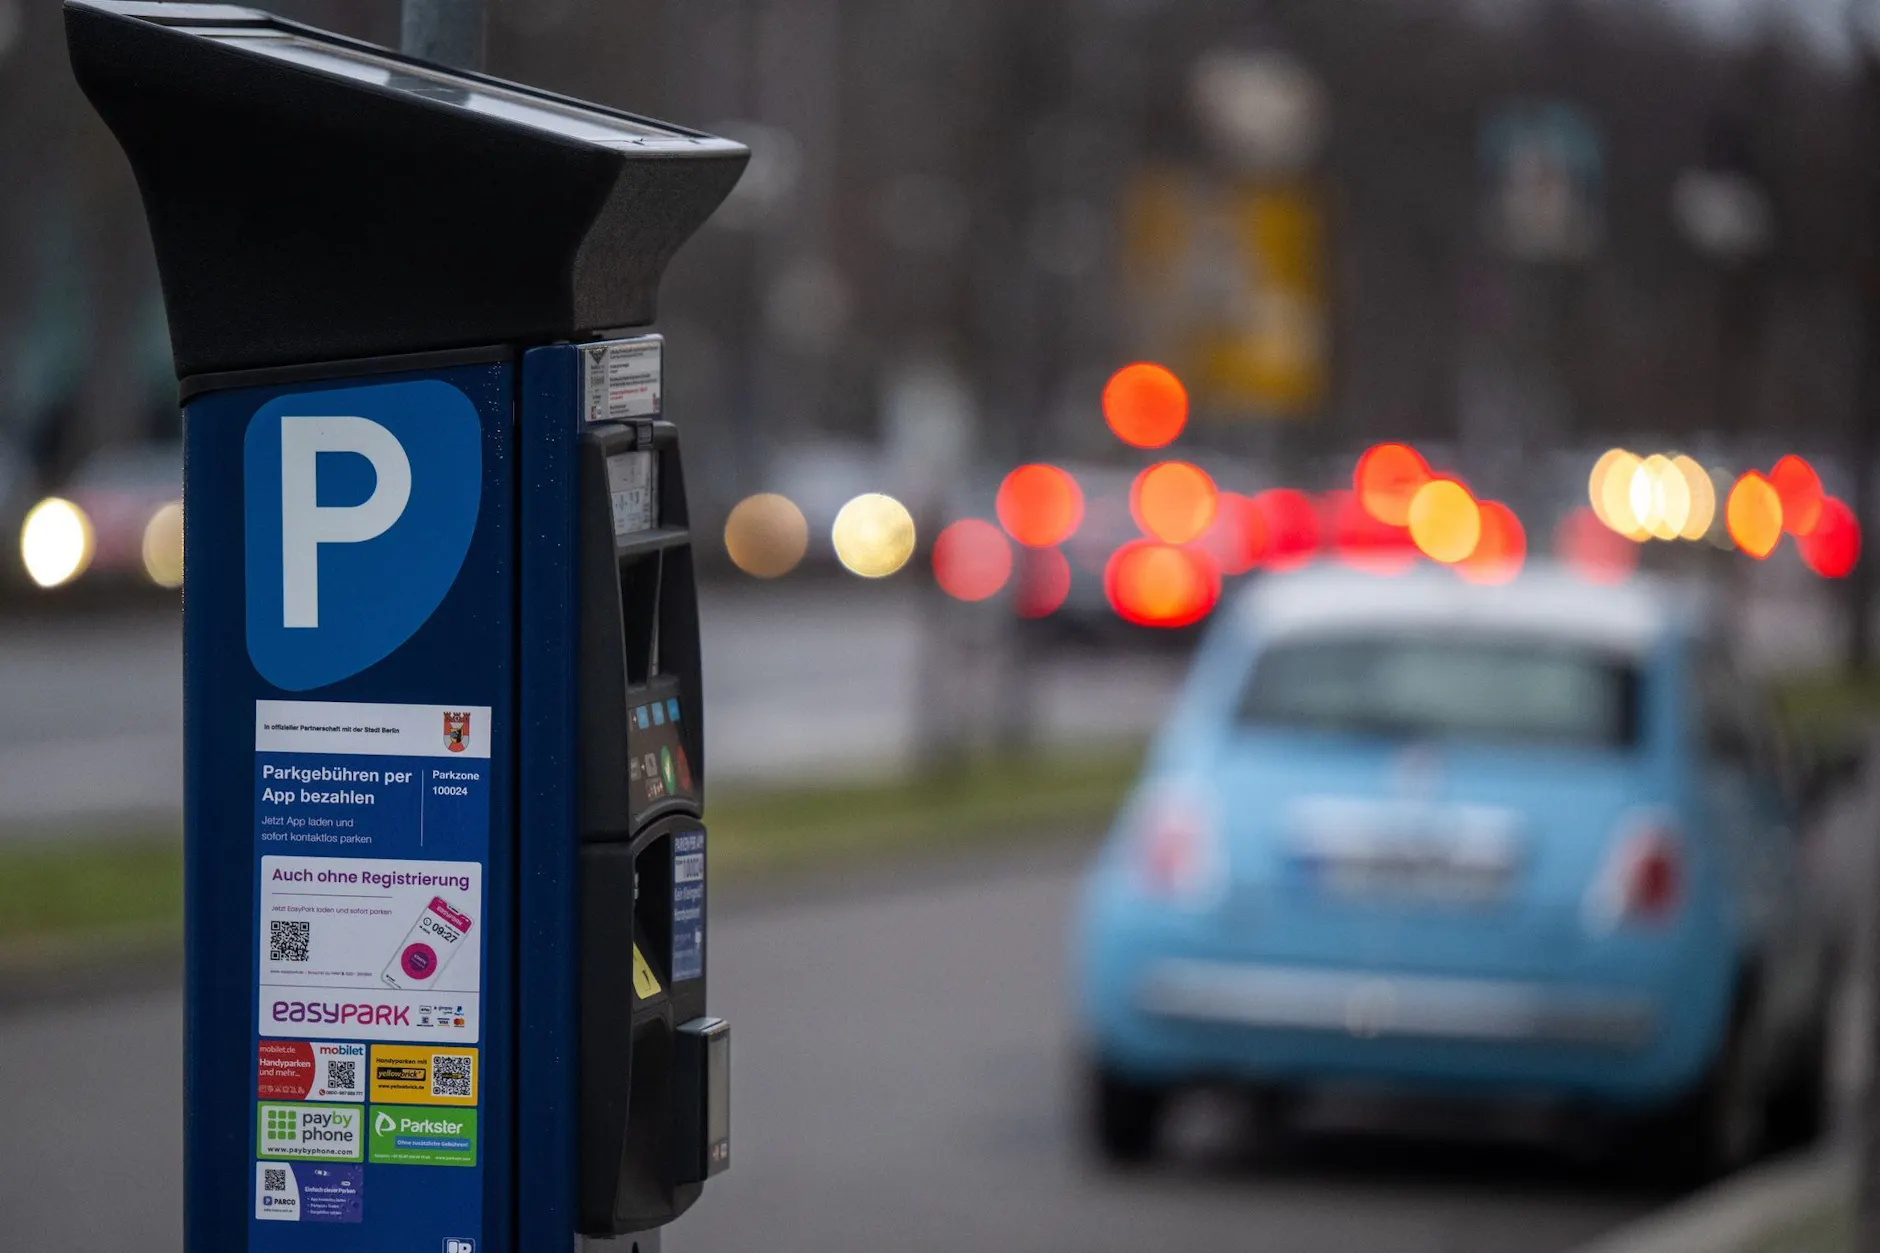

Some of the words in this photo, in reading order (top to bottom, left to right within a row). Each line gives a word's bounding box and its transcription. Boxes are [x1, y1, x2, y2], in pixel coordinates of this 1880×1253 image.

[281, 416, 411, 628] P
[264, 765, 378, 782] Parkgebühren
[385, 772, 412, 785] per
[433, 771, 479, 780] Parkzone
[262, 788, 295, 804] App
[301, 789, 374, 804] bezahlen
[433, 788, 468, 796] 100024
[262, 816, 284, 825] Jetzt
[286, 817, 305, 827] App
[307, 818, 333, 826] laden
[262, 832, 288, 840] sofort
[291, 832, 337, 842] kontaktlos
[339, 835, 372, 844] parken
[272, 869, 312, 881] Auch
[318, 870, 357, 883] ohne
[362, 872, 469, 891] Registrierung
[432, 923, 457, 944] 09:27
[320, 1045, 363, 1055] mobilet
[260, 1058, 310, 1068] Handyparken
[400, 1118, 463, 1134] Parkster
[303, 1127, 352, 1143] phone
